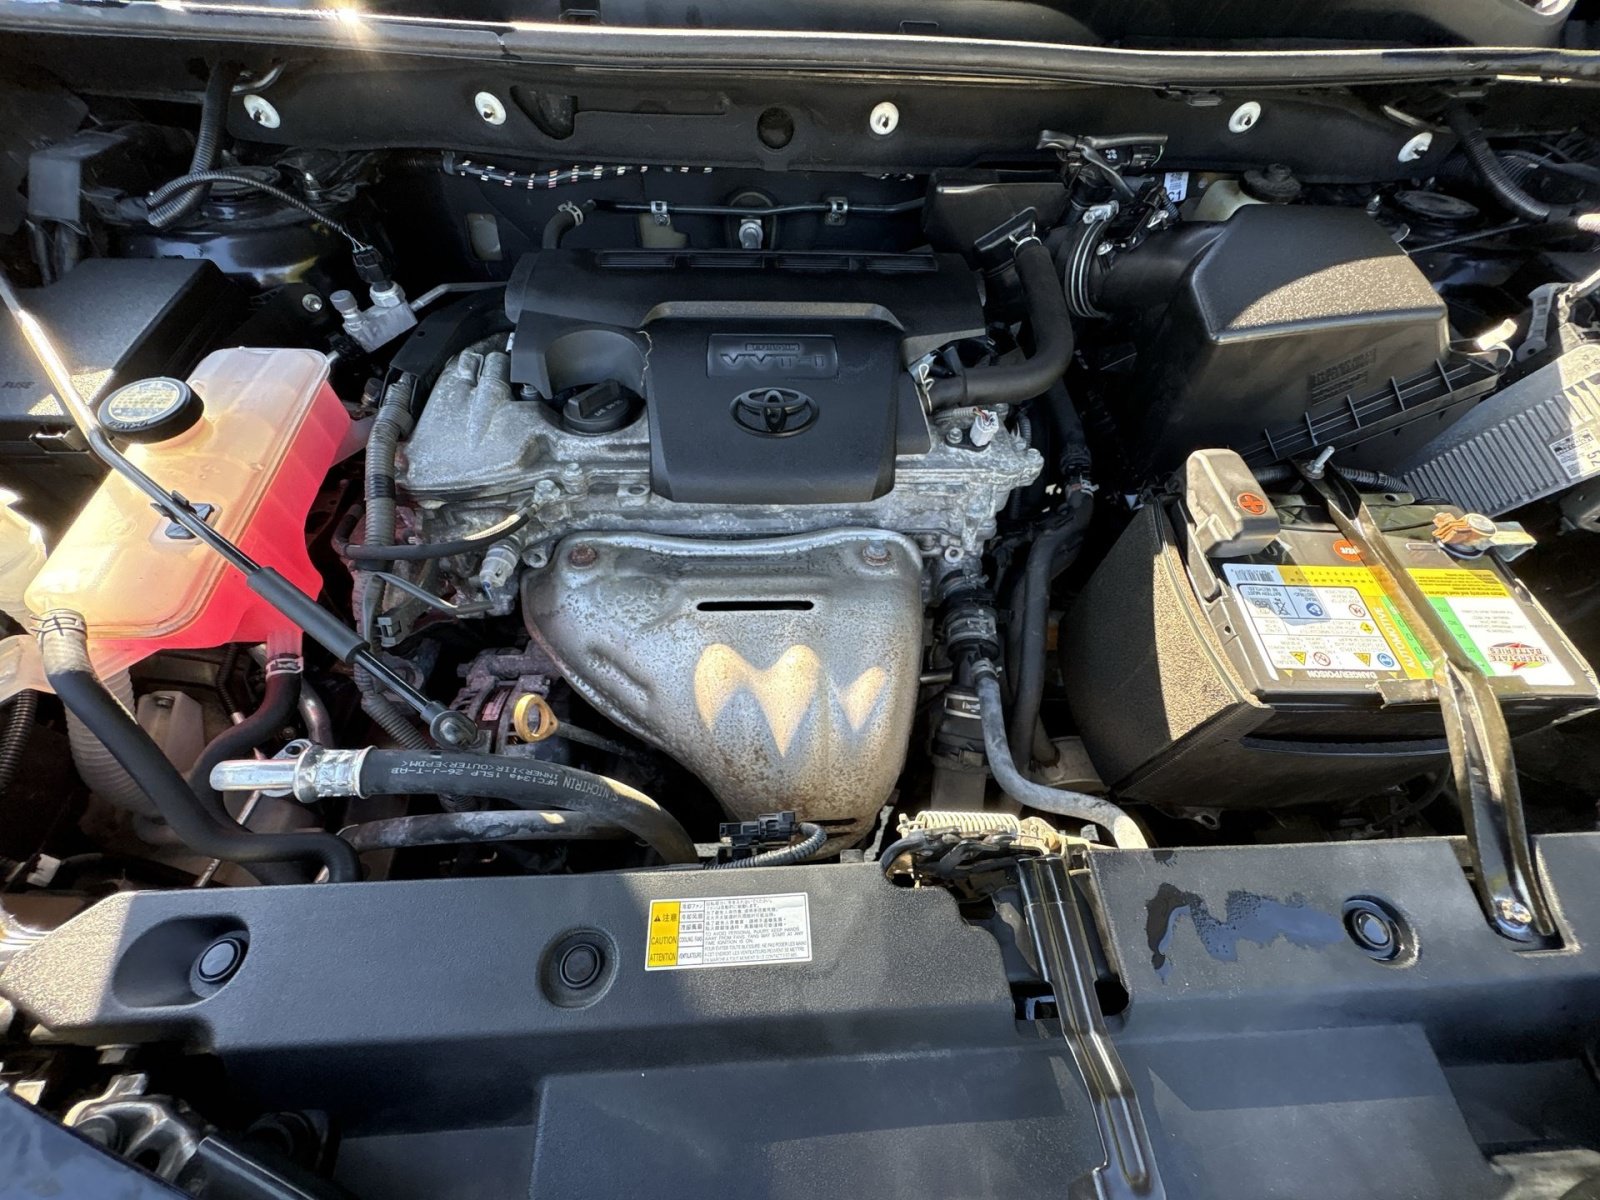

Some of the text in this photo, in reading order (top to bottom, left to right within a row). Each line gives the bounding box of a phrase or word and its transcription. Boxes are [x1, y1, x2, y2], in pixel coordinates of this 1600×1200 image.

[1373, 607, 1416, 670] AUTOMOTIVE
[1489, 647, 1542, 656] BATTERIES
[1489, 654, 1550, 663] INTERSTATE
[1306, 670, 1378, 679] DANGER/POISON
[508, 773, 559, 787] HFC134a
[662, 913, 678, 922] 注意
[651, 936, 677, 945] CAUTION
[649, 952, 676, 962] ATTENTION
